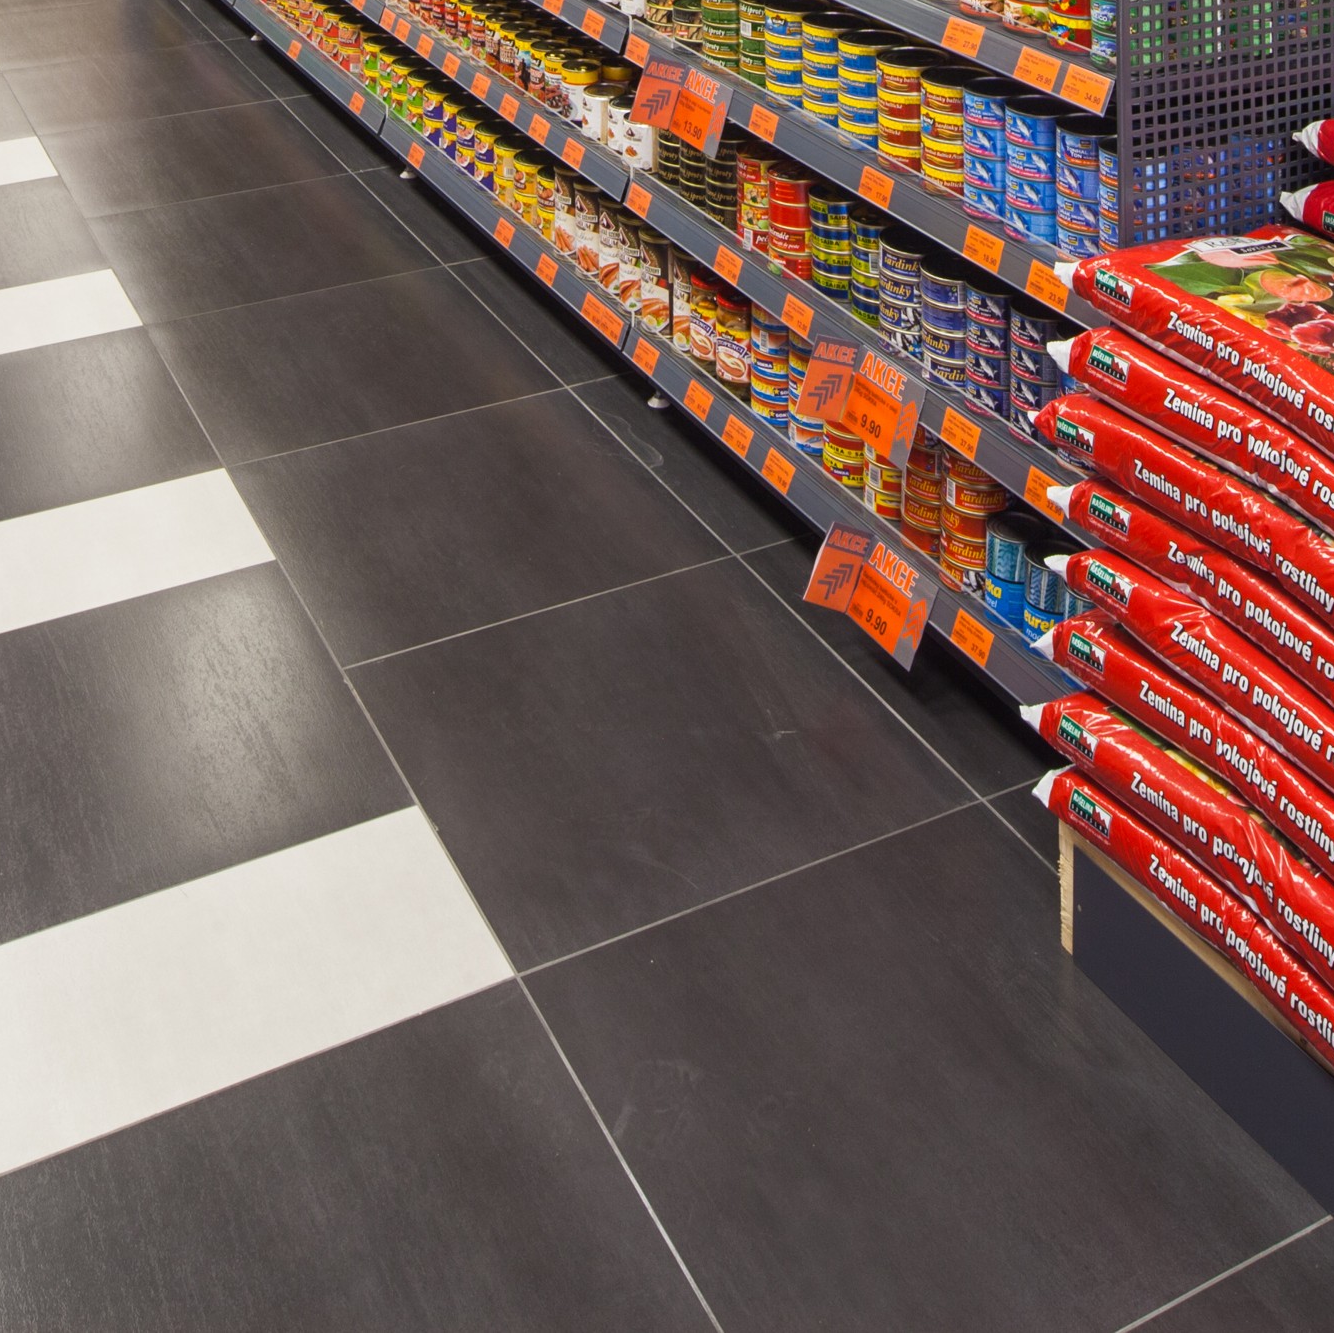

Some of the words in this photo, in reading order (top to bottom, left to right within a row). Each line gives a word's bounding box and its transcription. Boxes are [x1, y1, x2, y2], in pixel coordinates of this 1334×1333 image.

[648, 60, 685, 83] AKCE
[684, 68, 720, 105] AKCE
[683, 119, 703, 140] 13.90
[813, 341, 857, 365] AKCE
[1169, 311, 1214, 353] Zemina
[1217, 341, 1241, 367] pro
[1242, 357, 1305, 410] pokojové
[860, 351, 907, 399] AKCE
[859, 412, 882, 440] 9.90
[827, 529, 870, 557] AKCE
[868, 543, 919, 598] AKCE
[864, 607, 888, 637] 9.90
[1170, 621, 1221, 672] Zemina
[1221, 661, 1250, 694] pro
[1252, 683, 1324, 752] pokojové
[1149, 853, 1198, 913] Zemina
[1200, 904, 1224, 936] pro
